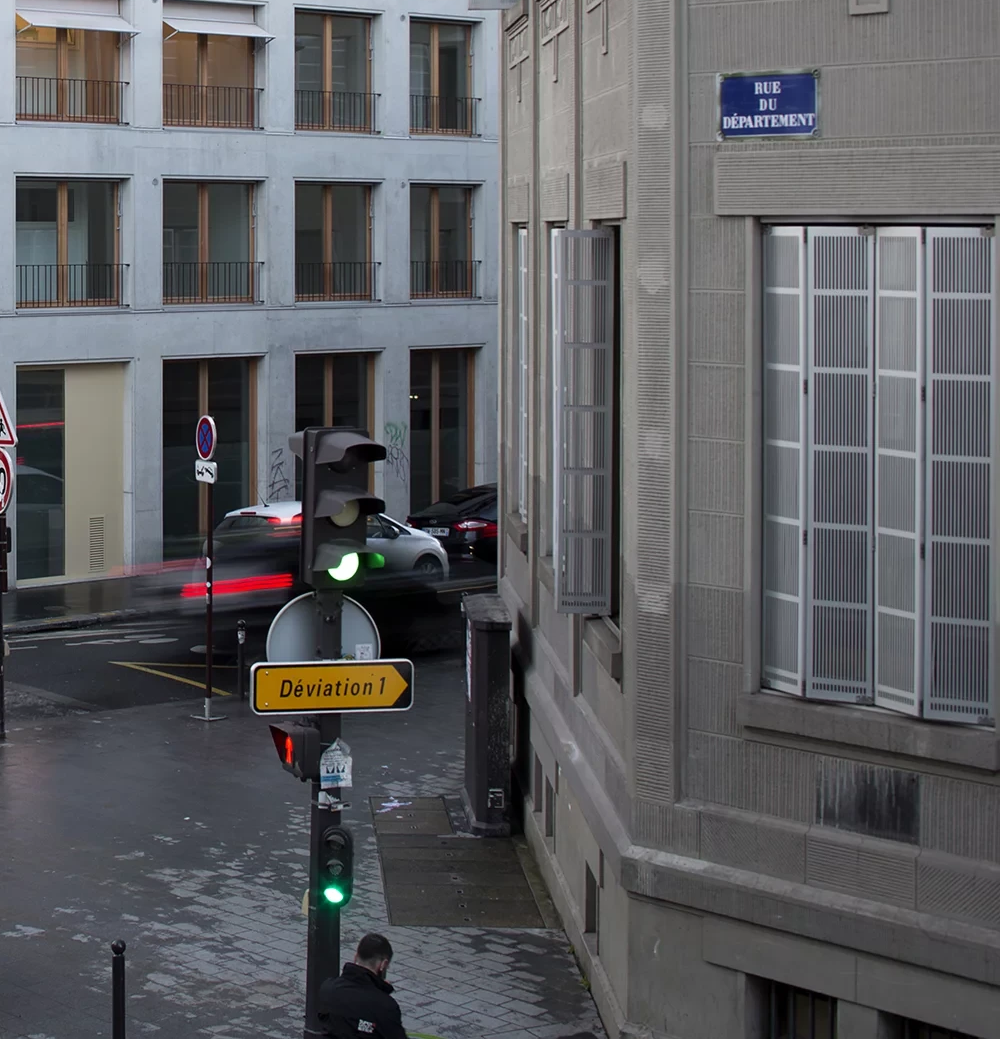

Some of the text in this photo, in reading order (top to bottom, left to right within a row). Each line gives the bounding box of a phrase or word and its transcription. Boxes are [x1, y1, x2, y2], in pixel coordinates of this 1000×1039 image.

[754, 81, 781, 95] RUE
[759, 98, 777, 111] DU
[722, 113, 816, 129] DÉPARTEMENT
[279, 676, 387, 698] Déviation 1
